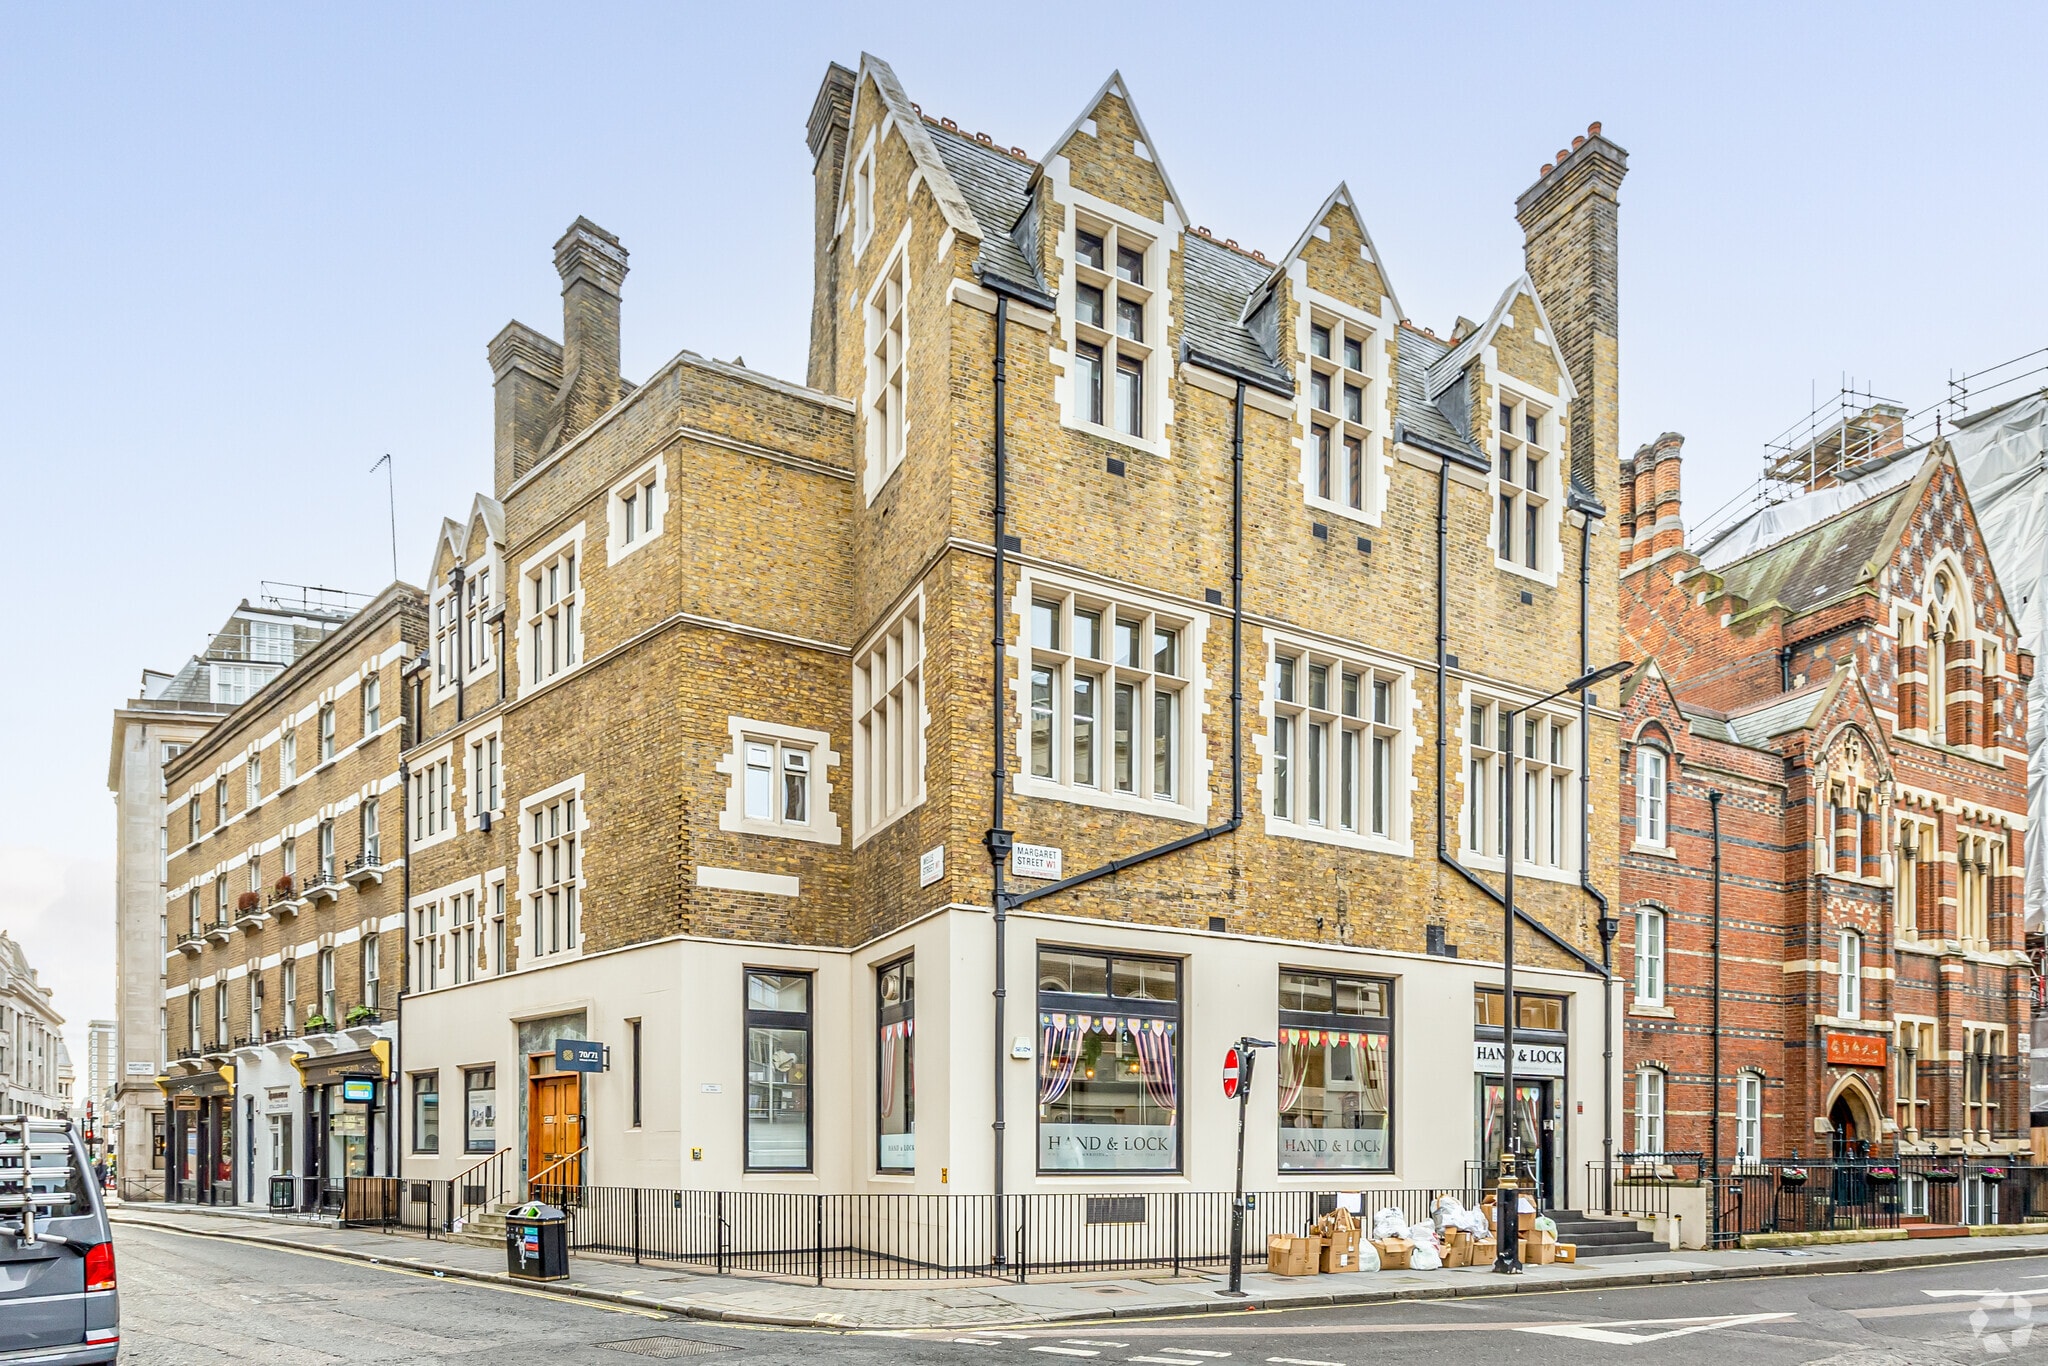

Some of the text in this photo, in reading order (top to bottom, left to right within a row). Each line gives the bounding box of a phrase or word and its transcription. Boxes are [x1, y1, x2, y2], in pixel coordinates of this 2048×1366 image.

[923, 853, 934, 865] WELLS
[1017, 847, 1057, 859] MARGARET
[923, 862, 935, 876] STREET
[1017, 856, 1056, 869] STREET W1
[578, 1050, 599, 1059] 70/71
[1518, 1049, 1527, 1062] &
[1530, 1049, 1562, 1064] LOCK
[1048, 1136, 1168, 1151] HAND & LOCK
[1285, 1139, 1381, 1152] HAND & LOCK
